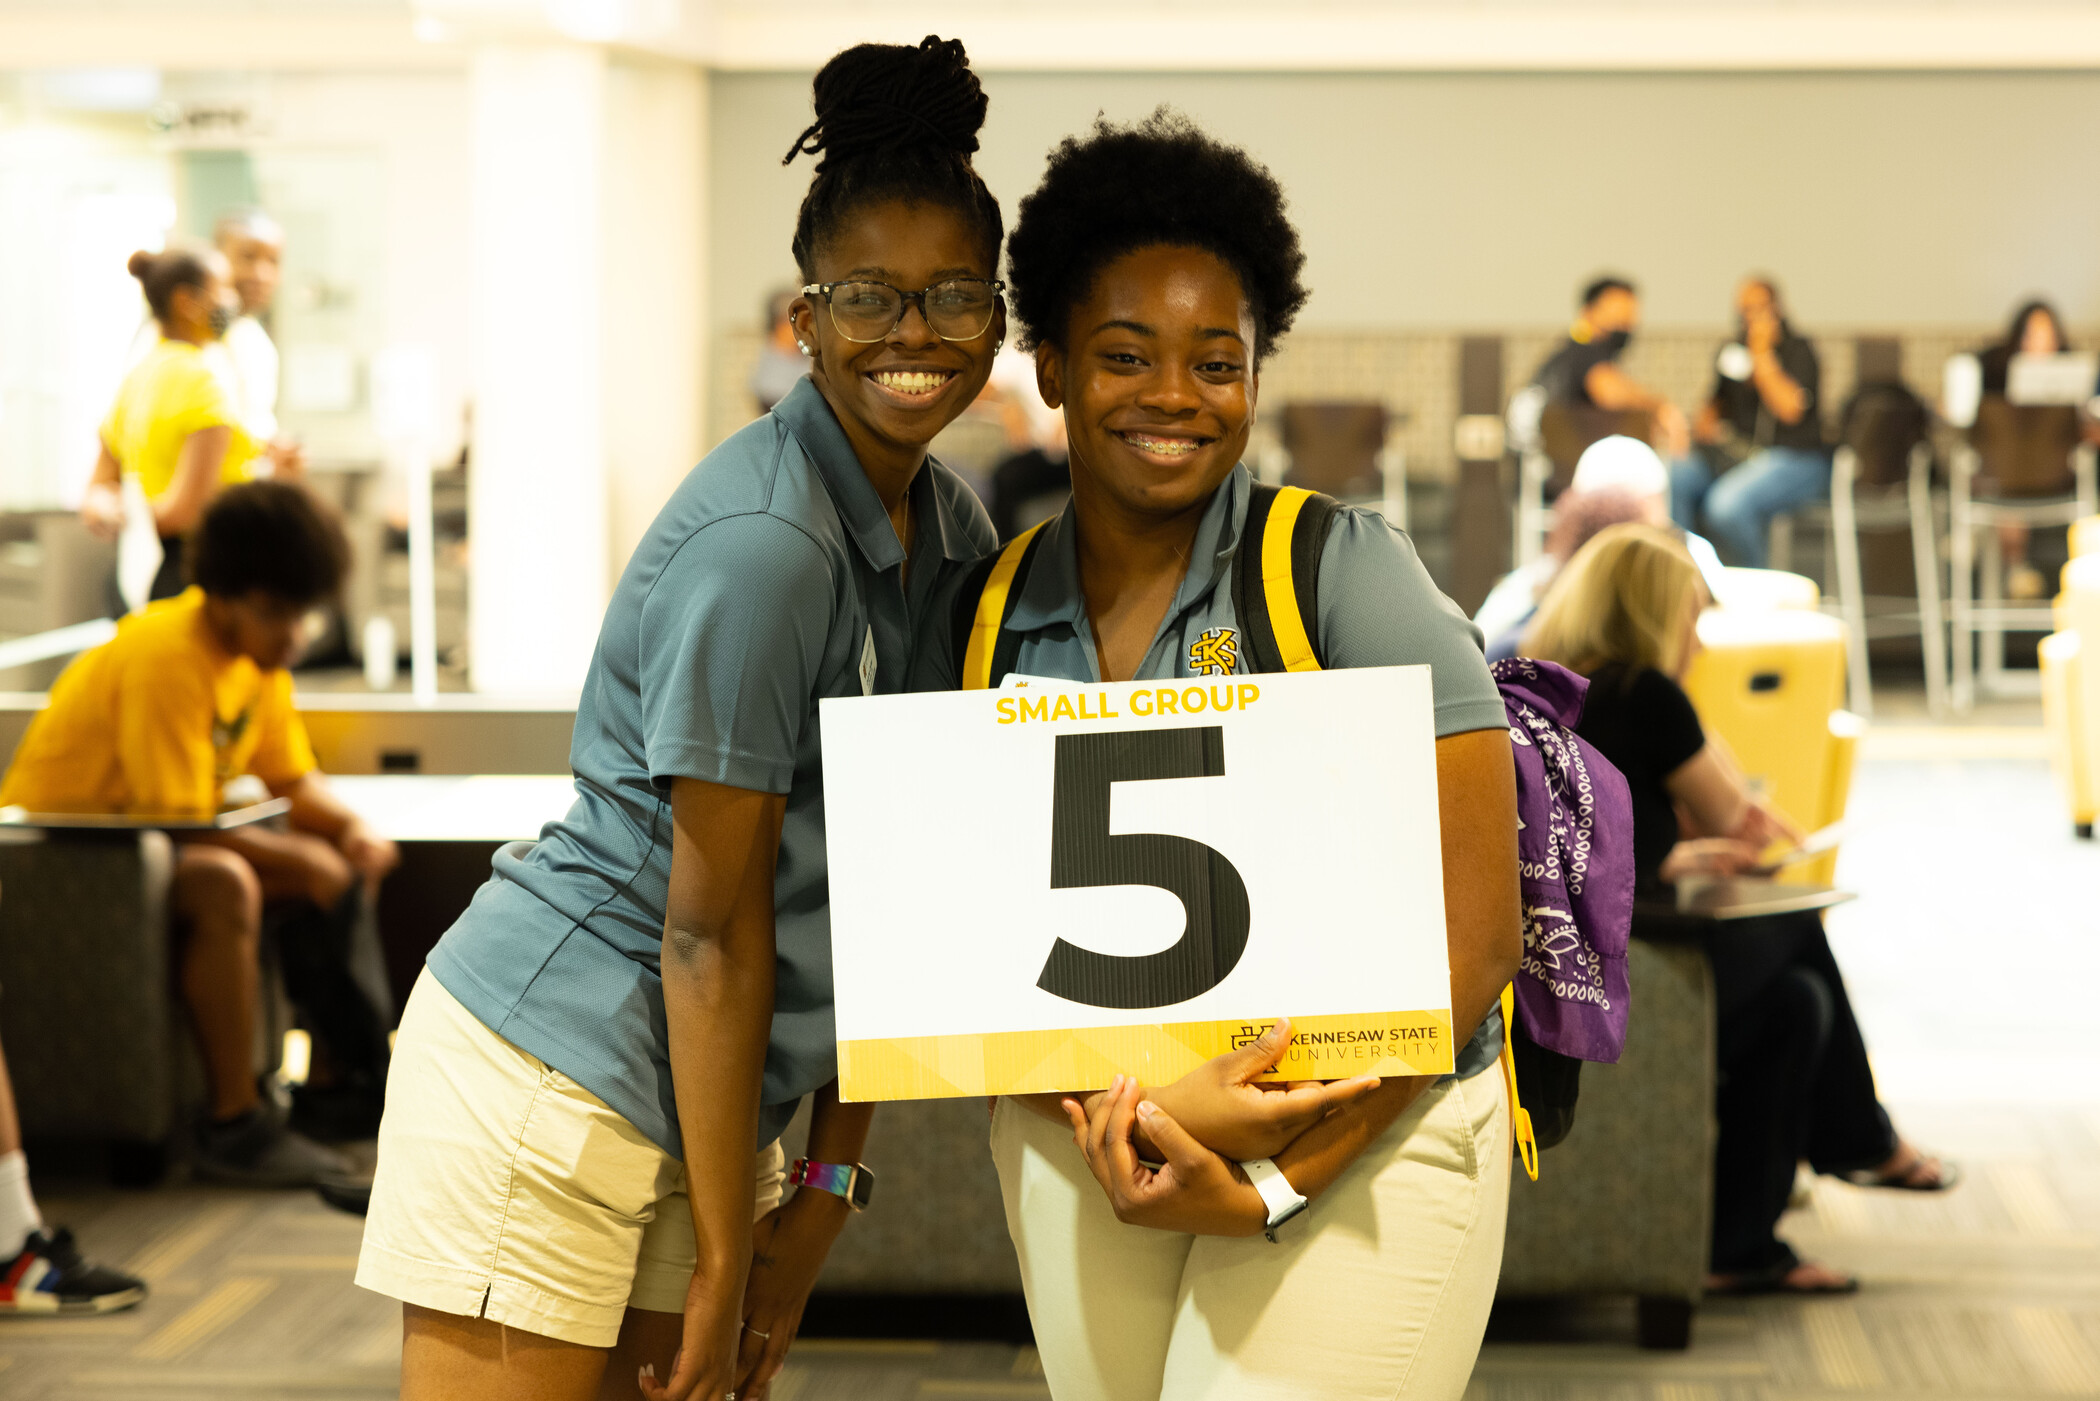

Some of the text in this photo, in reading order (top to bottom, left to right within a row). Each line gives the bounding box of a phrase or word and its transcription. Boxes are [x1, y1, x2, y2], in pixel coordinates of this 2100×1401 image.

[996, 683, 1260, 724] SMALL GROUP
[1036, 725, 1251, 1009] 5
[1289, 1027, 1438, 1046] KENNESAW STATE
[1290, 1042, 1439, 1063] UNIVERSITY
